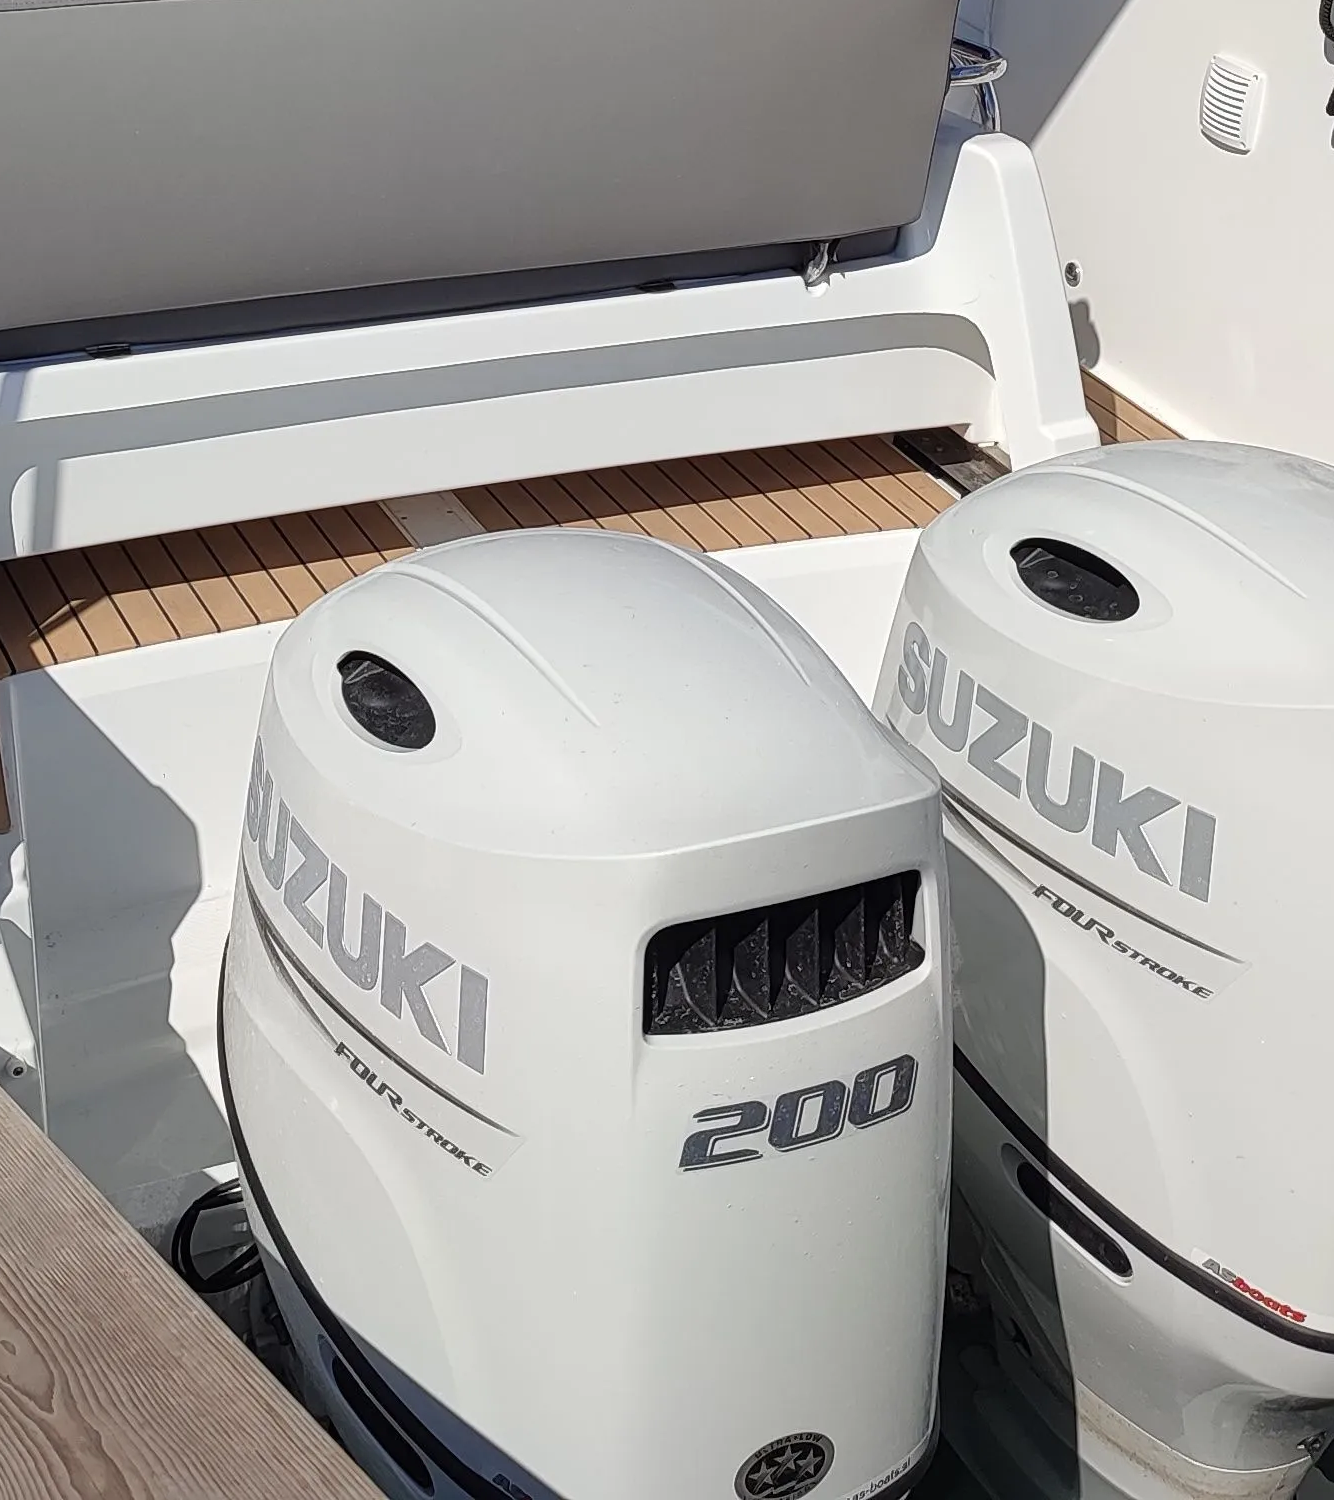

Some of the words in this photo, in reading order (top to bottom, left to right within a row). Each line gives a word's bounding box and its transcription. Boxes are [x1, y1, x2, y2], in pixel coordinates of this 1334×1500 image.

[897, 619, 1217, 903] SUZUKI
[246, 734, 489, 1075] SUZUKI
[677, 1053, 919, 1171] 200
